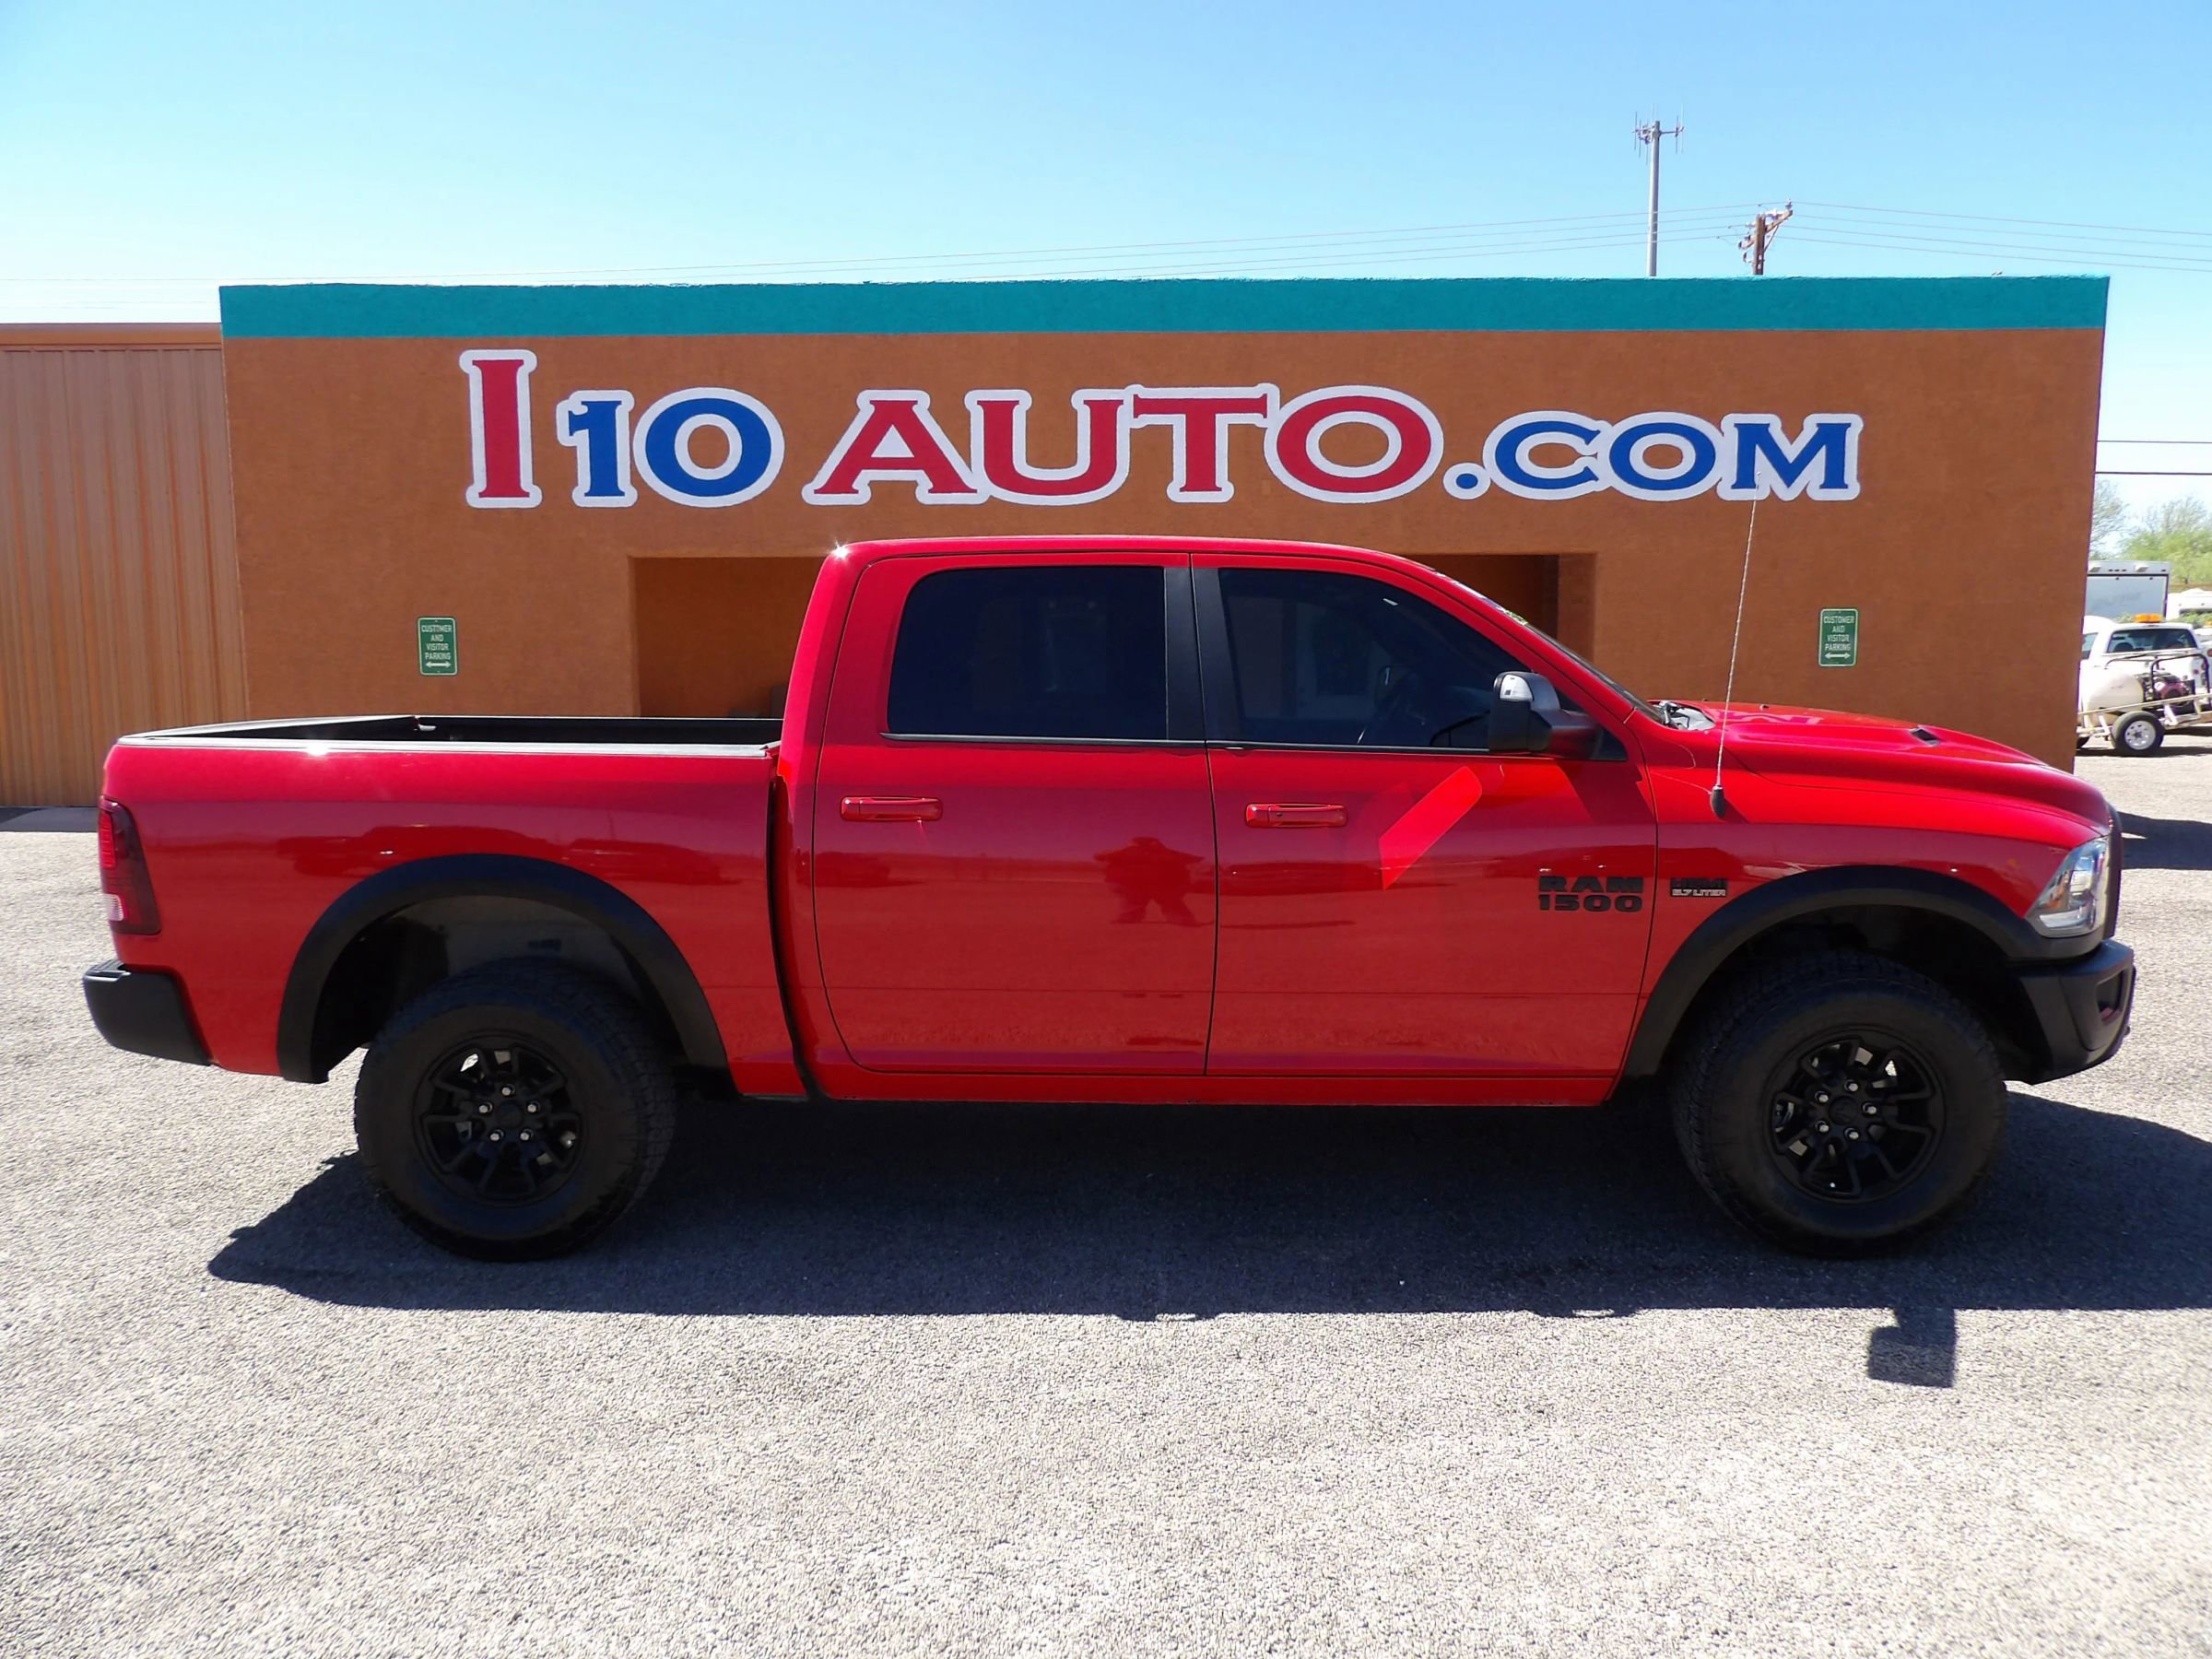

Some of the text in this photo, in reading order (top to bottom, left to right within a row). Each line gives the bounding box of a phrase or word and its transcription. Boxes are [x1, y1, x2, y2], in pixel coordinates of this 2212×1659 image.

[1824, 616, 1854, 624] CUSTOMER
[1827, 634, 1849, 642] VISITOR
[1825, 643, 1851, 652] PARKING
[1538, 876, 1643, 893] RAM
[1692, 888, 1726, 897] LITER
[1538, 894, 1642, 912] 1500
